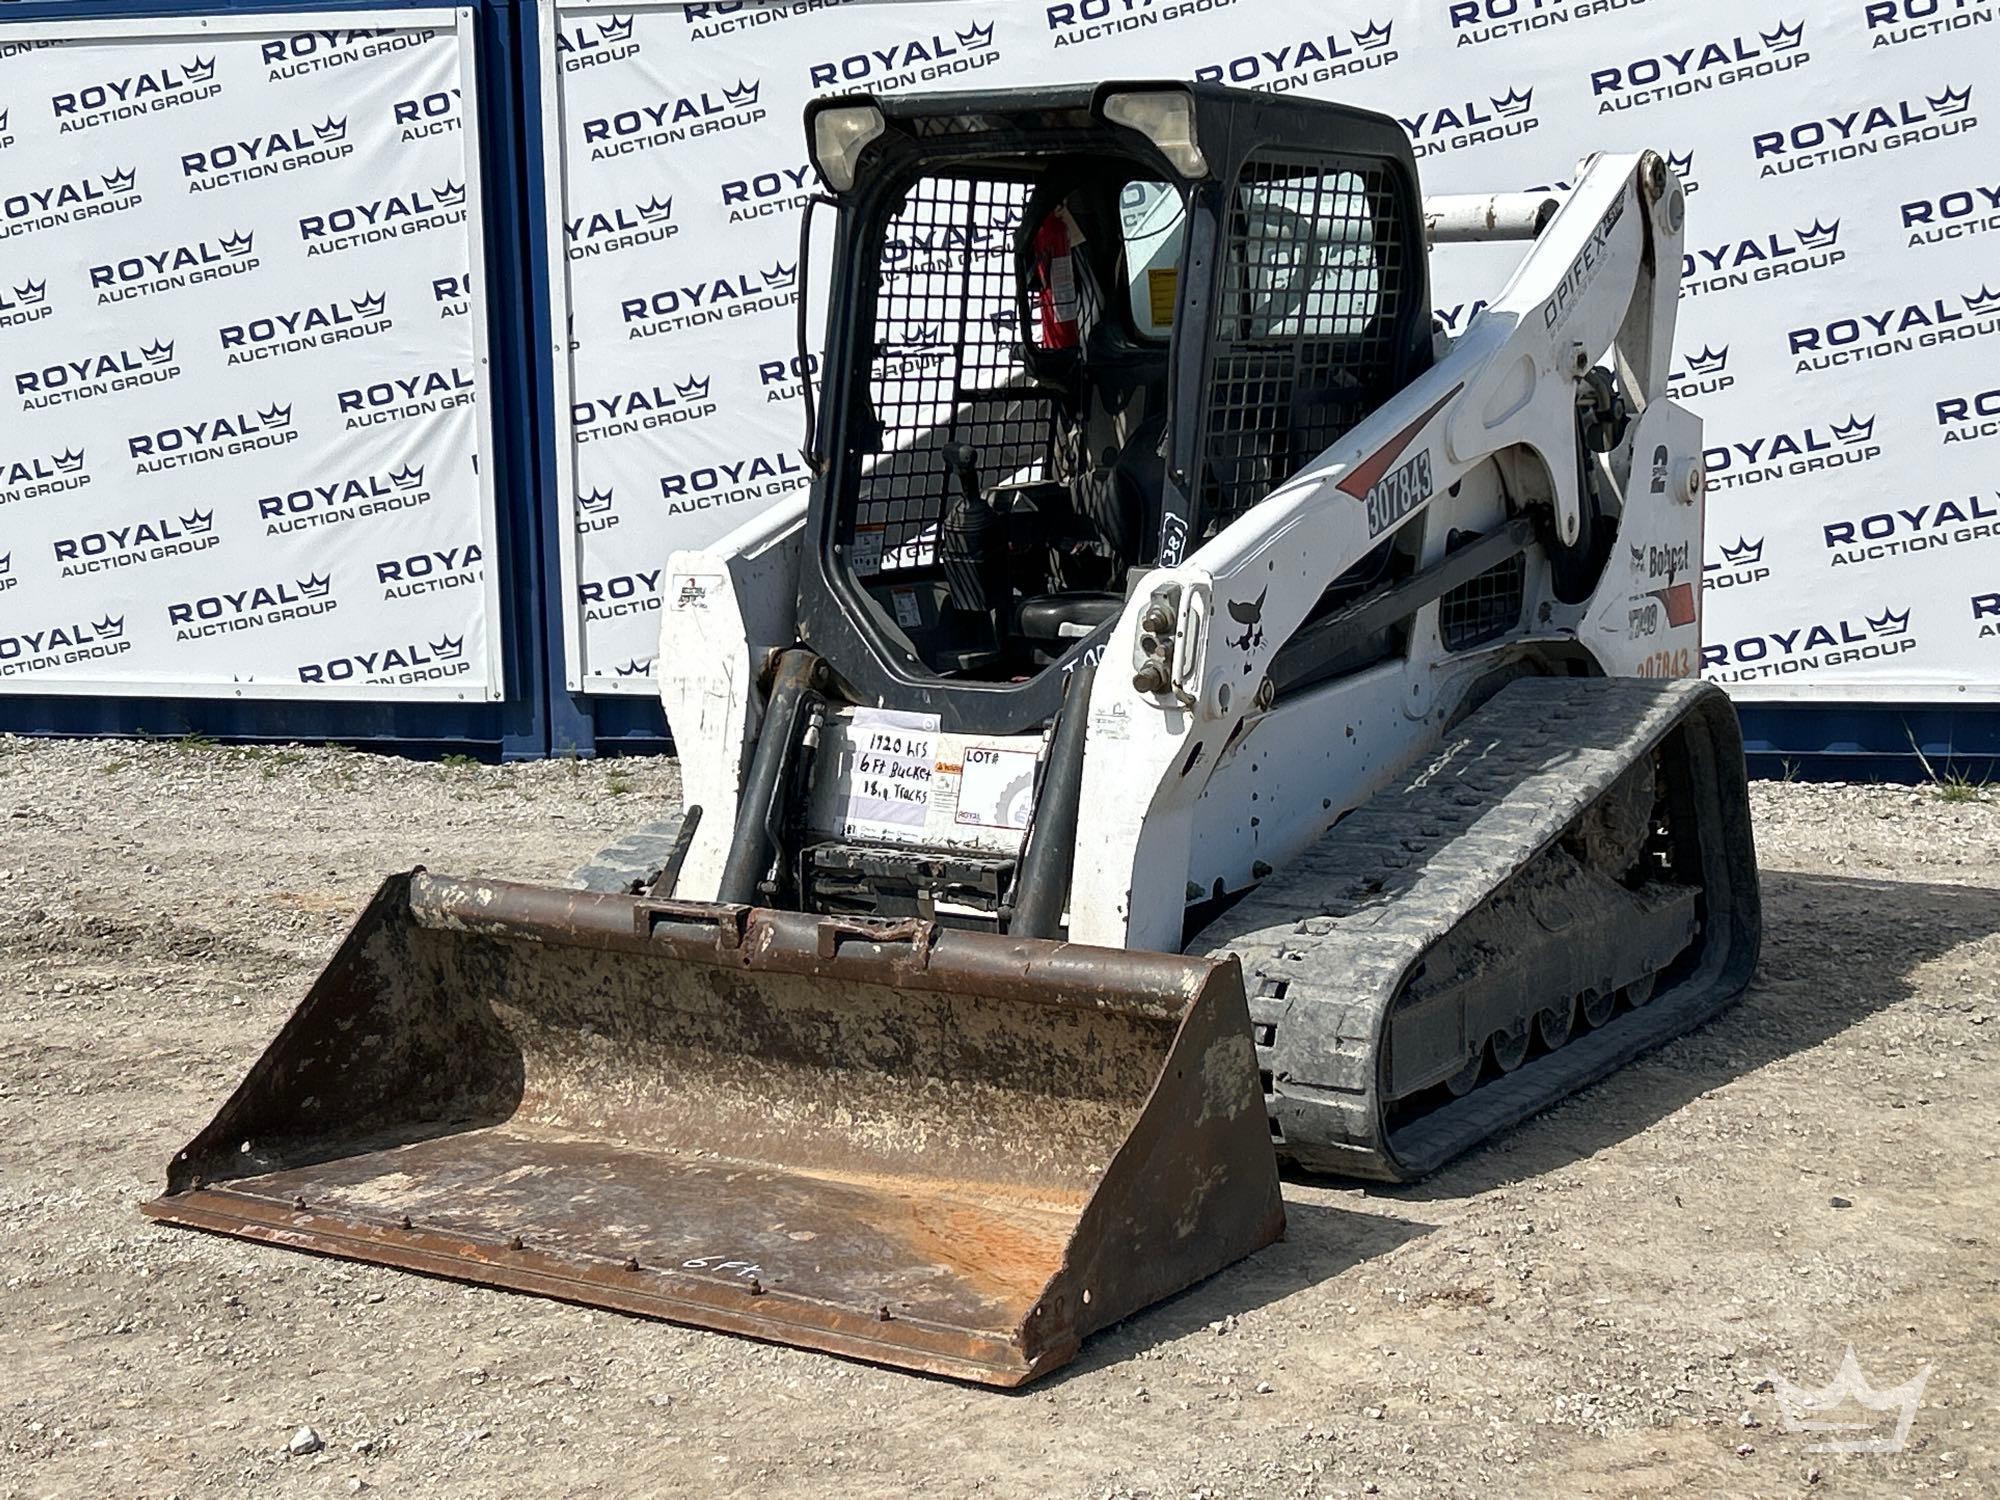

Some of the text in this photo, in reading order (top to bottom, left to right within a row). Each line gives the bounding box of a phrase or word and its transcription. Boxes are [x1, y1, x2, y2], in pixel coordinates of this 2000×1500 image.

[691, 5, 788, 41] AUCTION
[1054, 11, 1157, 48] AUCTION
[1457, 9, 1568, 47] AUCTION
[1873, 9, 1992, 48] AUCTION
[269, 30, 435, 82] AUCTION GROUP
[566, 44, 640, 72] GROUP
[810, 36, 957, 88] ROYAL
[921, 51, 1000, 80] GROUP
[1251, 51, 1398, 94] TION GROUP
[1591, 37, 1760, 96] ROYAL
[52, 69, 183, 117] ROYAL
[1599, 53, 1809, 115] AUCTION GROUP
[60, 84, 221, 134] AUCTION GROUP
[402, 117, 461, 142] AUCTI
[583, 93, 724, 143] ROYAL
[1398, 102, 1491, 139] YAL
[592, 109, 766, 161] AUCTION GROUP
[1451, 118, 1538, 149] GROUP
[1753, 101, 1927, 159] ROYAL
[1761, 117, 1977, 178] AUCTION GROUP
[181, 129, 314, 176] ROYAL
[189, 144, 353, 193] AUCTION GROUP
[0, 180, 103, 221] OYAL
[722, 165, 820, 205] ROY
[0, 195, 142, 239] UCTION GROUP
[299, 192, 434, 240] ROYAL
[565, 209, 638, 240] YAL
[730, 194, 809, 223] AUCTIO
[1901, 186, 2000, 228] ROY
[308, 226, 397, 257] AUCTION
[605, 225, 678, 251] GROUP
[89, 243, 221, 288] ROYAL
[98, 259, 259, 305] AUCTION GROUP
[1754, 251, 1845, 281] GROUP
[0, 306, 52, 328] ROUP
[621, 275, 762, 322] ROYAL
[220, 304, 353, 349] ROYAL
[228, 320, 392, 366] AUCTION GROUP
[630, 309, 723, 339] AUCTION
[1788, 300, 1962, 355] ROYAL
[1796, 319, 2000, 374] AUCTION GROU
[15, 351, 142, 395] ROYAL
[24, 367, 180, 411] AUCTION GROUP
[338, 368, 474, 413] ROYAL
[1665, 375, 1735, 400] ROUP
[346, 401, 436, 430] AUCTION
[571, 387, 676, 426] OYAL
[575, 404, 716, 443] CTION GROUP
[128, 414, 259, 458] ROYAL
[137, 431, 298, 475] AUCTION GROUP
[1703, 429, 1831, 473] OYAL
[24, 475, 90, 498] GROUP
[660, 453, 800, 498] ROYAL
[1703, 446, 1880, 492] CTION GROUP
[259, 476, 391, 519] ROYAL
[669, 486, 761, 515] AUCTION
[1367, 449, 1431, 535] 307843
[267, 492, 430, 536] AUCTION GROUP
[576, 515, 620, 534] OUP
[1823, 495, 1997, 548] ROYAL
[54, 520, 182, 561] ROYAL
[62, 536, 219, 578] AUCTION GROUP
[1831, 533, 1948, 566] AUCTION
[376, 545, 482, 583] ROYA
[1703, 568, 1770, 590] ROUP
[168, 584, 299, 626] ROYAL
[385, 572, 475, 600] AUCTION
[578, 569, 661, 605] ROY
[177, 600, 337, 641] AUCTION GROUP
[585, 597, 662, 622] AUCTIO
[0, 625, 94, 659] OYAL
[0, 641, 131, 677] CTION GROUP
[1699, 621, 1867, 669] ROYAL
[1825, 639, 1916, 665] GROUP
[298, 646, 431, 683] ROYAL
[399, 662, 470, 684] GROUP
[860, 753, 870, 773] 6
